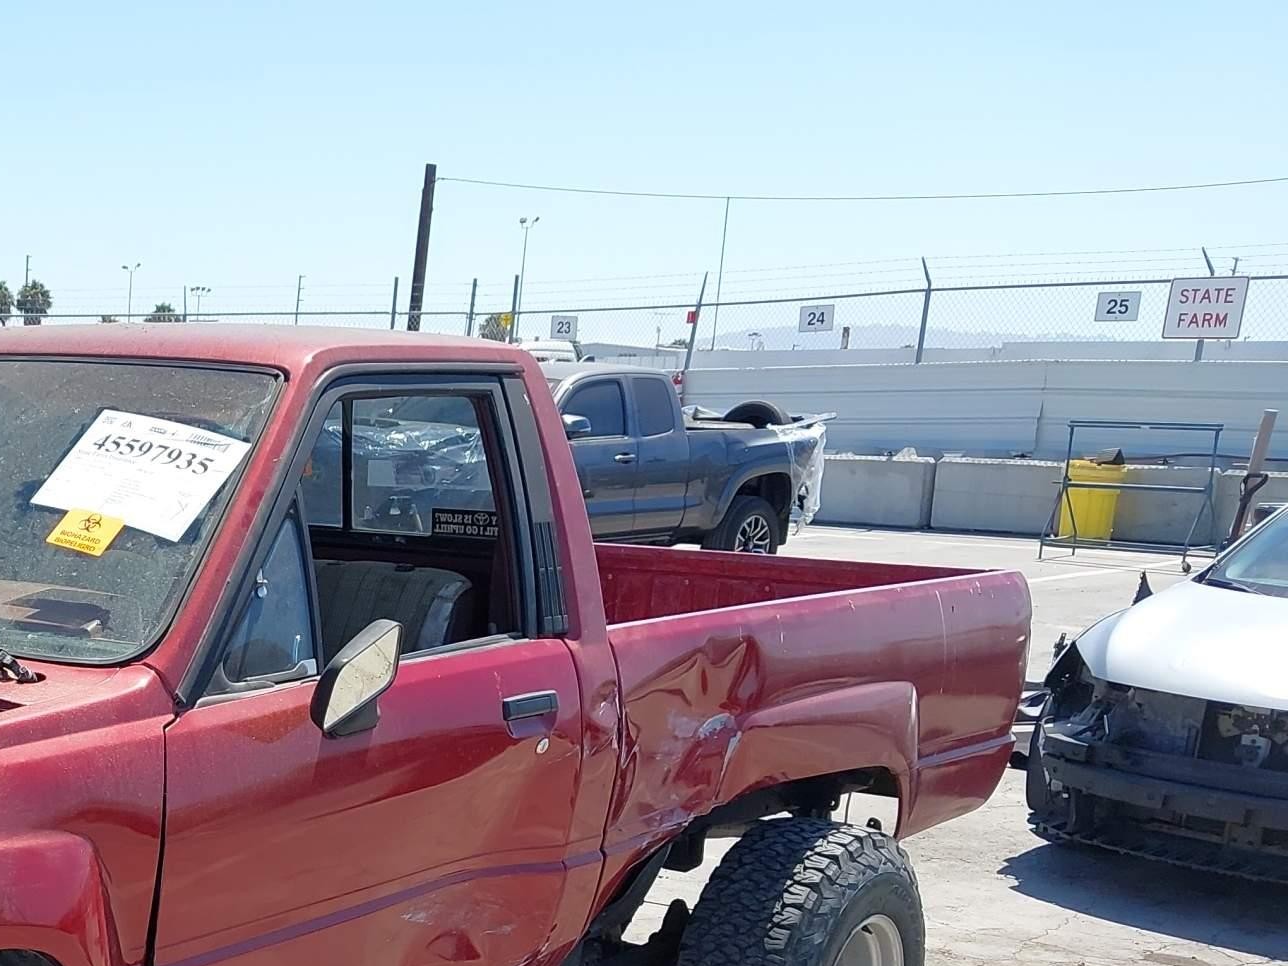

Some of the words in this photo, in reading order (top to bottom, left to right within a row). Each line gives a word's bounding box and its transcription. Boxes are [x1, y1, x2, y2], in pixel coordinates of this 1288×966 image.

[1179, 287, 1236, 305] STATE
[1106, 298, 1129, 315] 25
[807, 311, 825, 326] 24
[1177, 312, 1228, 329] FARM
[557, 321, 571, 334] 23
[92, 433, 215, 475] 45597935
[60, 530, 101, 545] BIOHAZARD
